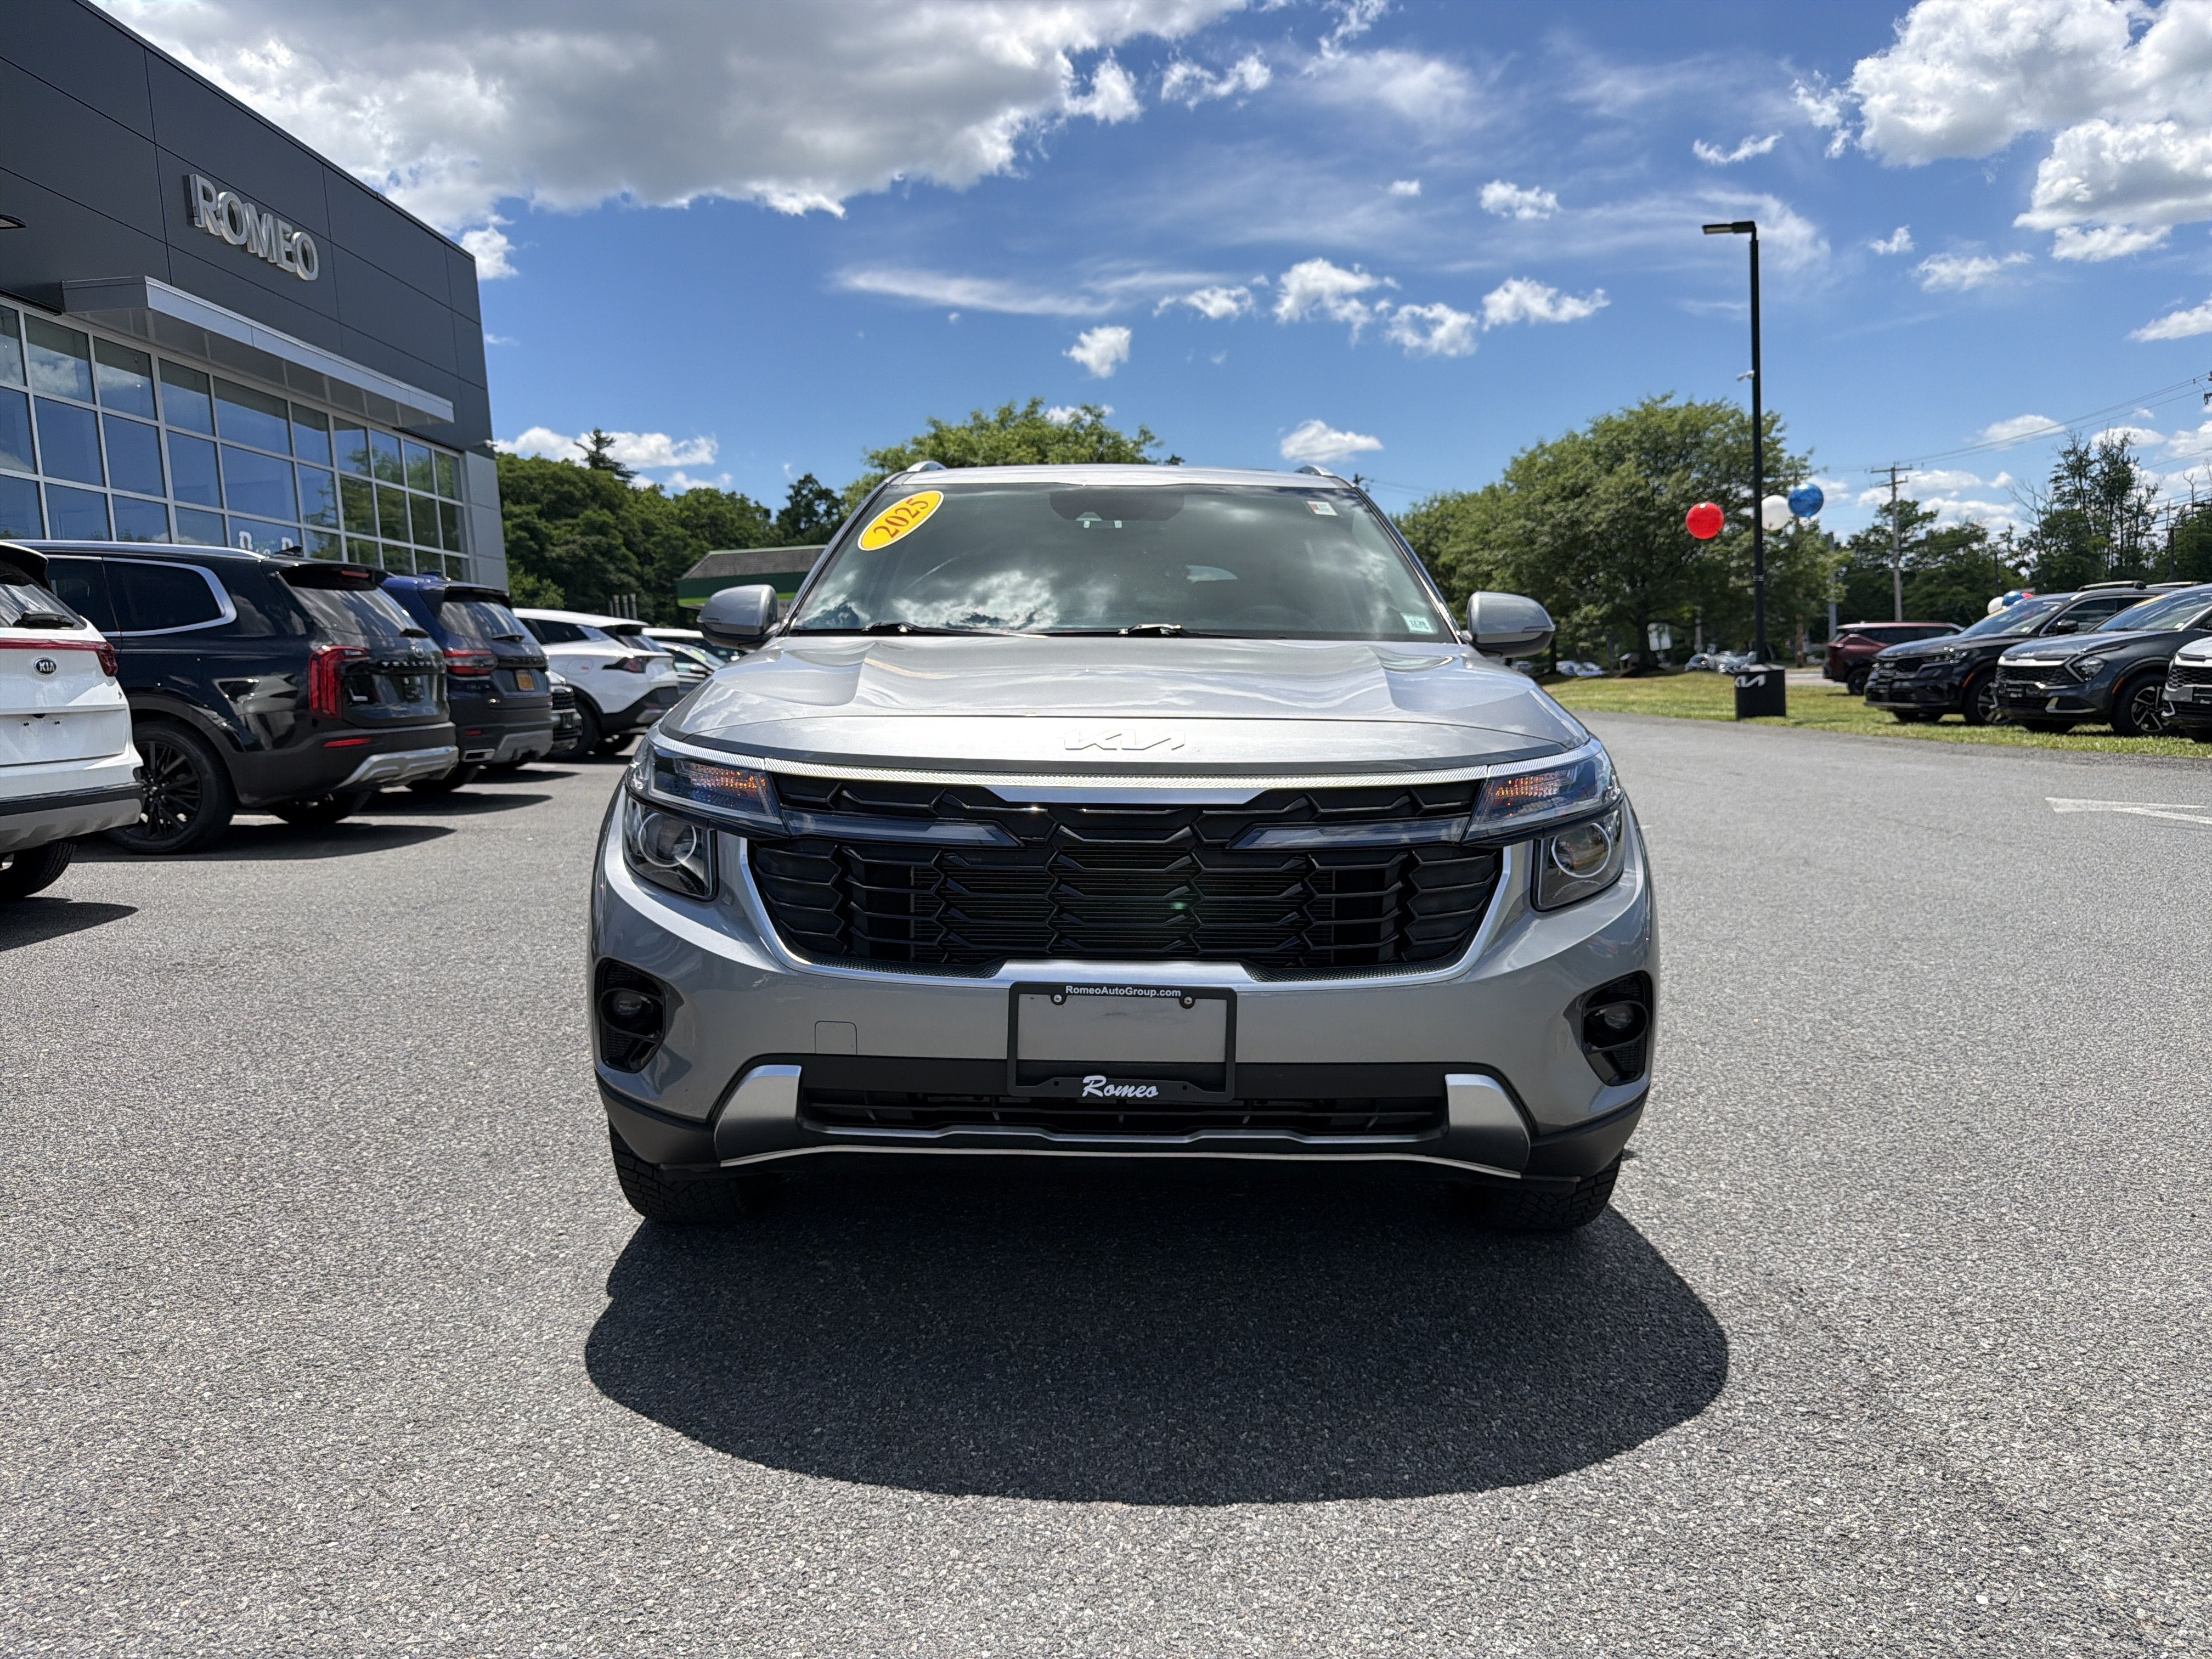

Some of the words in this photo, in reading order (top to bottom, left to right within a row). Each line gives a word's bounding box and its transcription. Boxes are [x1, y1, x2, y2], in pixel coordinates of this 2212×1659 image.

[190, 174, 319, 280] ROMEO
[873, 498, 929, 538] 2025
[39, 662, 55, 672] KIA
[1063, 729, 1186, 751] KIA
[1065, 986, 1181, 998] RomeoAutoGroup.com
[1082, 1075, 1159, 1098] Romeo
